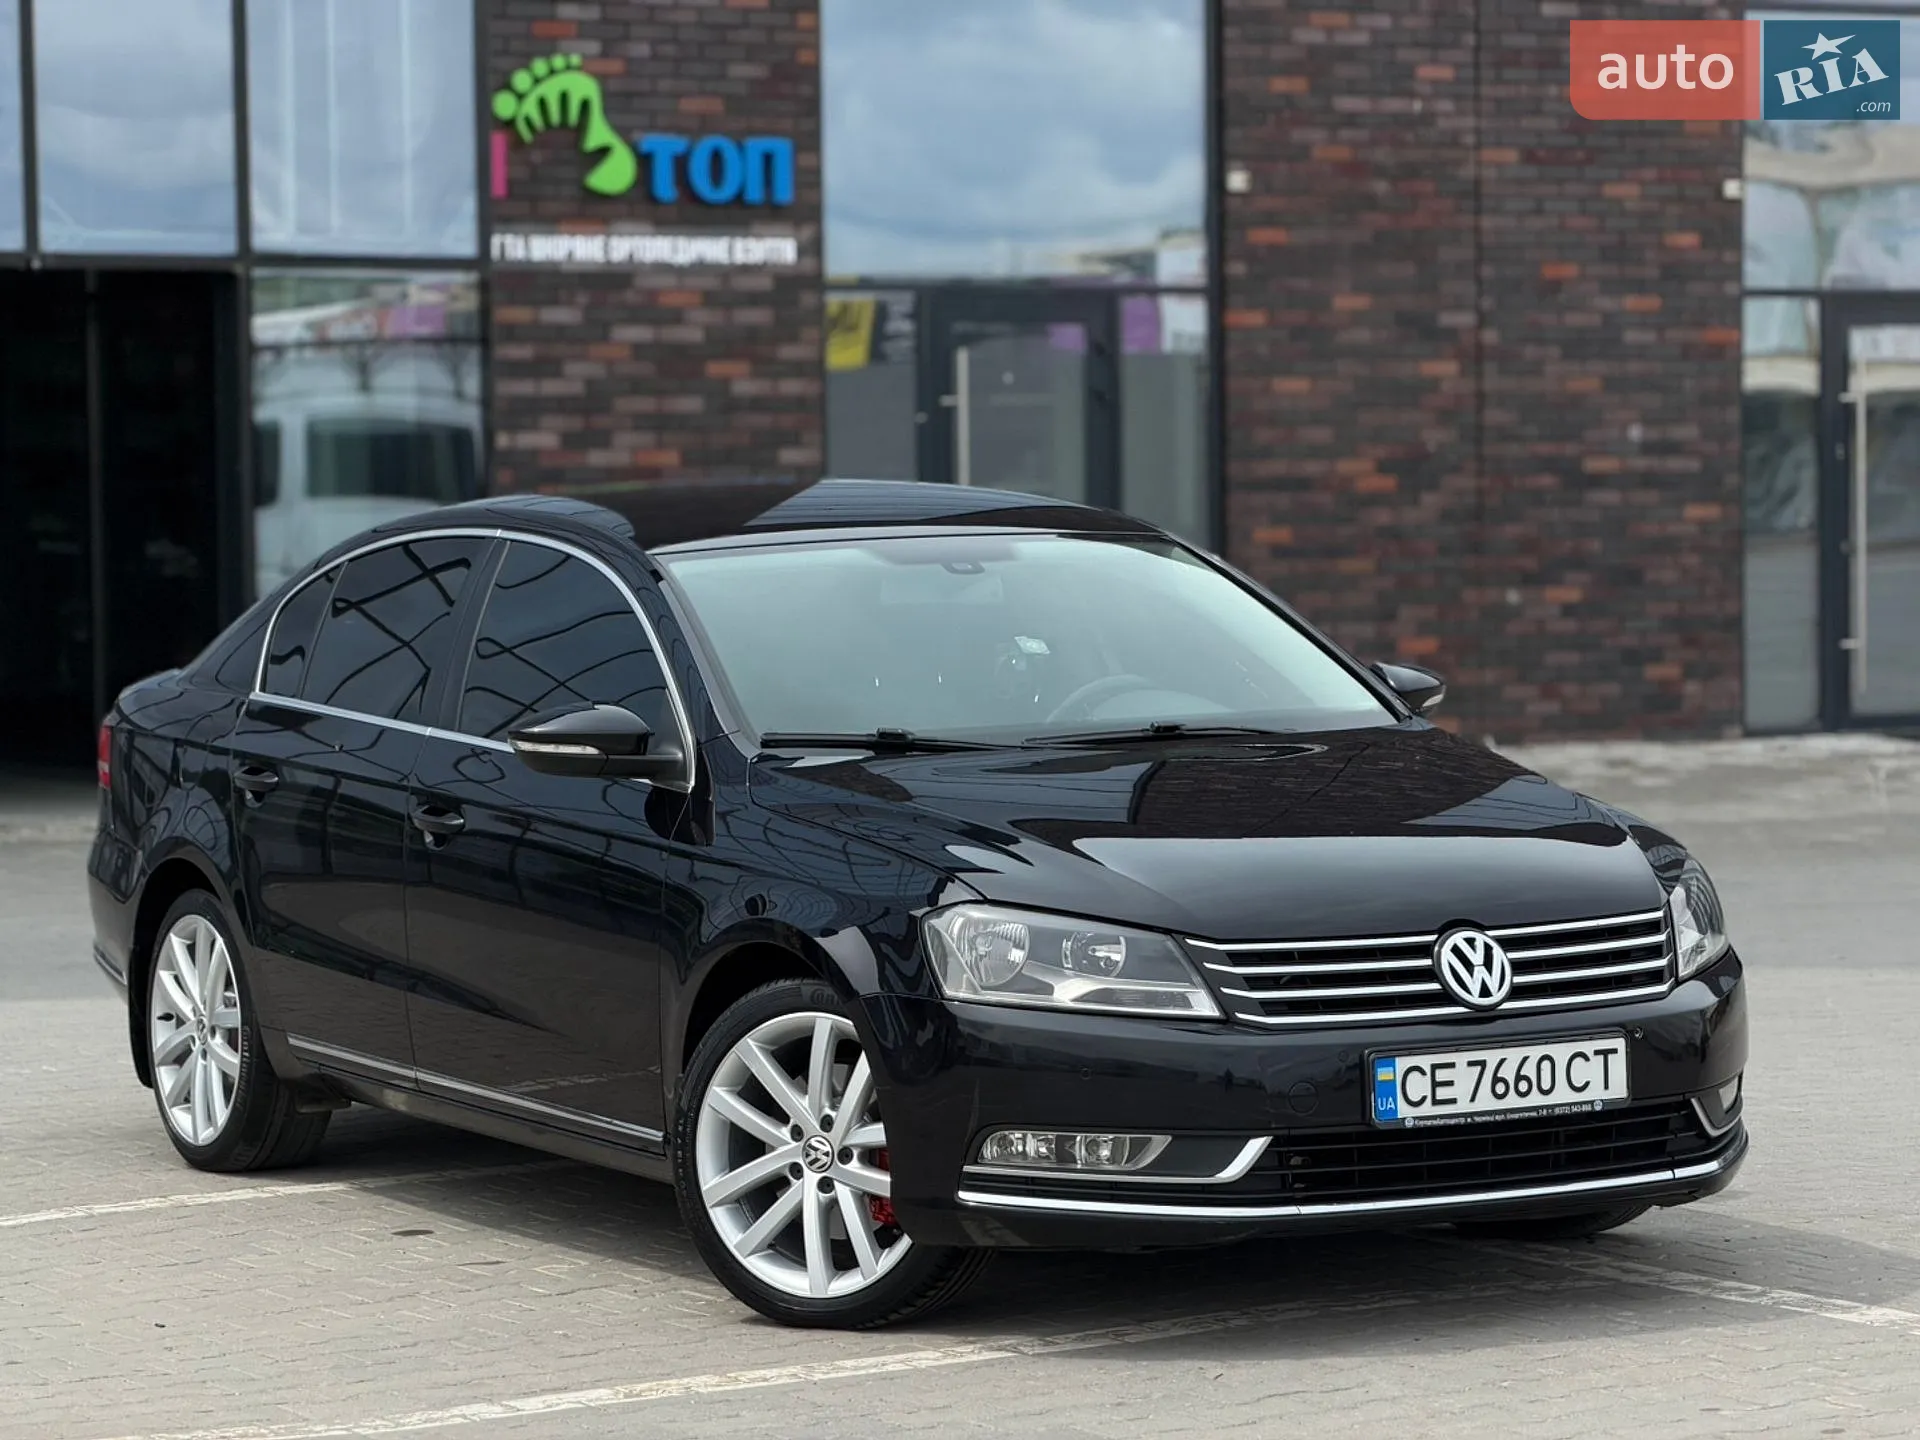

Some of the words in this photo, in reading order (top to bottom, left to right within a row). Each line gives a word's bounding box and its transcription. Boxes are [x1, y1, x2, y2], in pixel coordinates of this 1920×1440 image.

[638, 132, 795, 206] ТОП
[1377, 1096, 1396, 1112] UA
[1401, 1061, 1458, 1108] CE
[1466, 1053, 1556, 1103] 7660
[1565, 1047, 1619, 1093] CT
